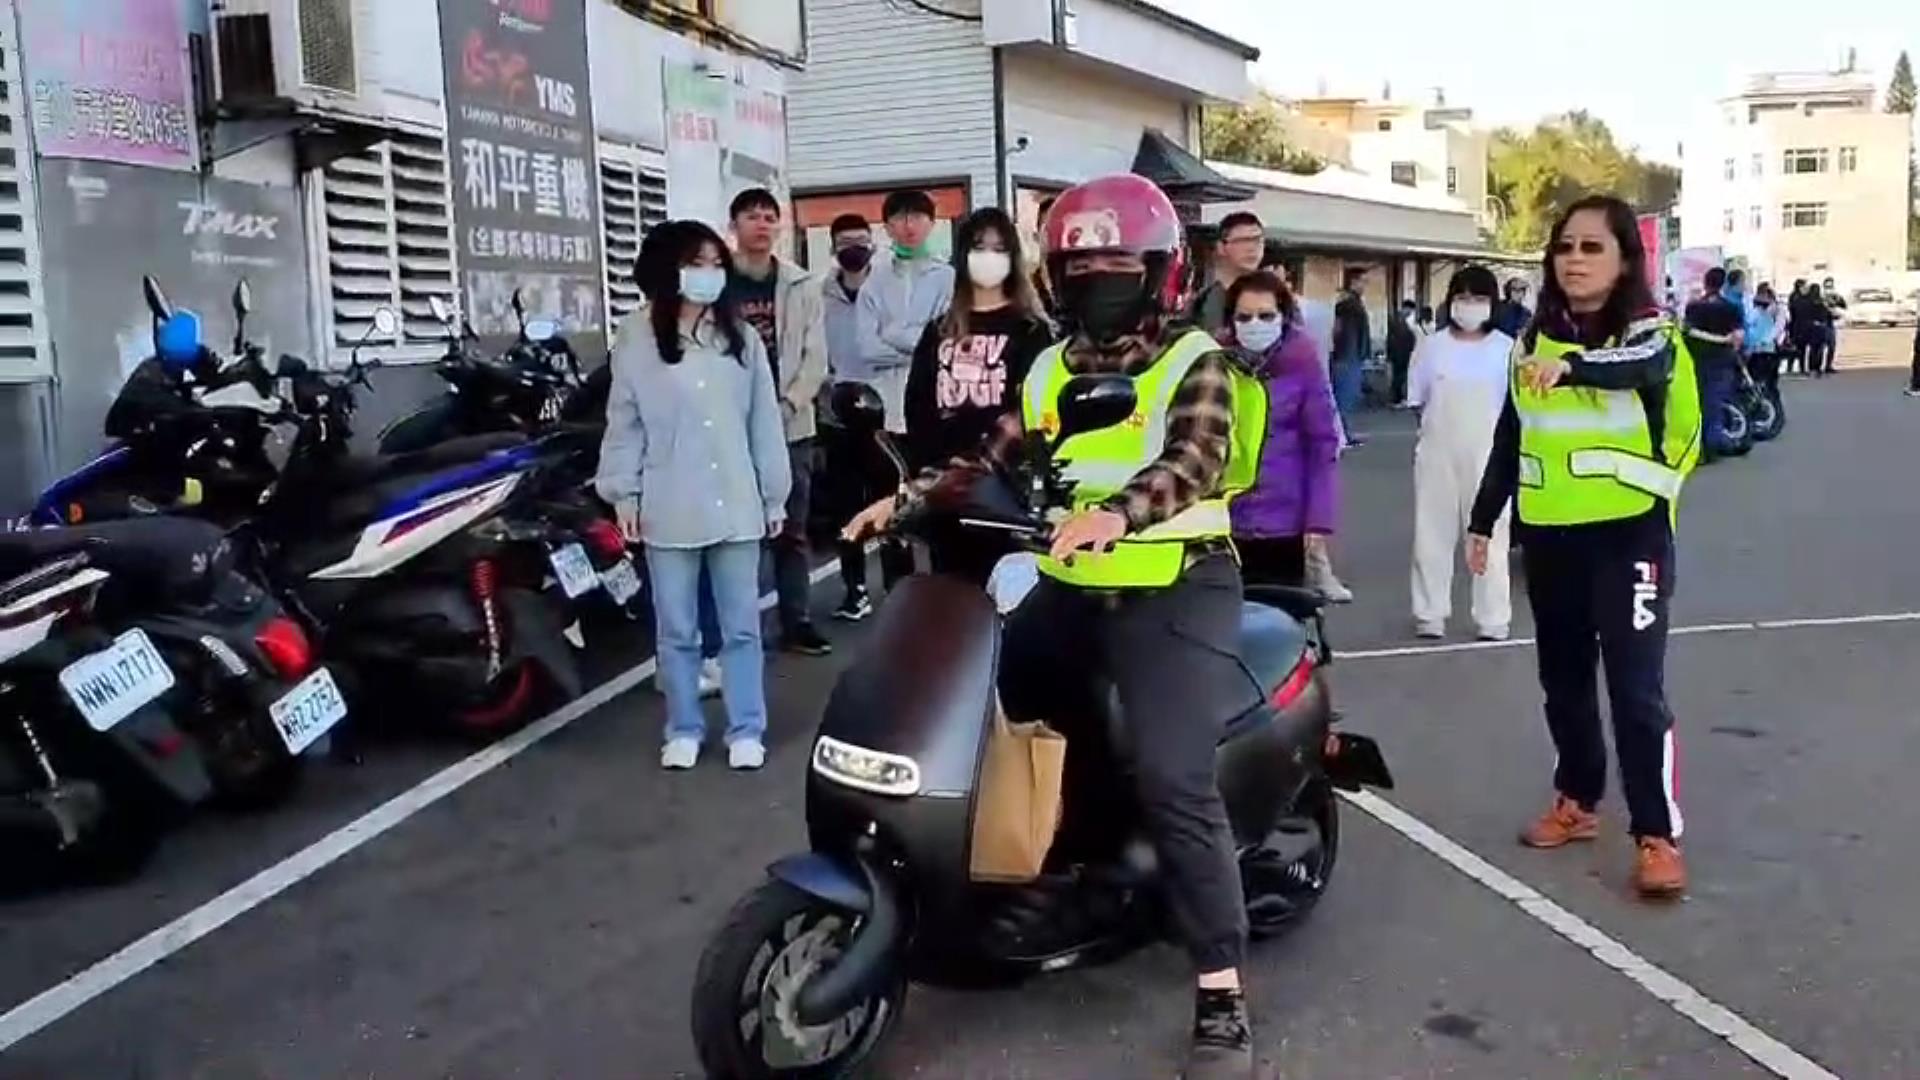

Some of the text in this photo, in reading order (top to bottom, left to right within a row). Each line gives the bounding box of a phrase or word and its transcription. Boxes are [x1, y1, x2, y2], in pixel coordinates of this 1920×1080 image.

[533, 73, 576, 116] YMS
[461, 137, 590, 222] 和平重機
[1633, 561, 1657, 630] FILA
